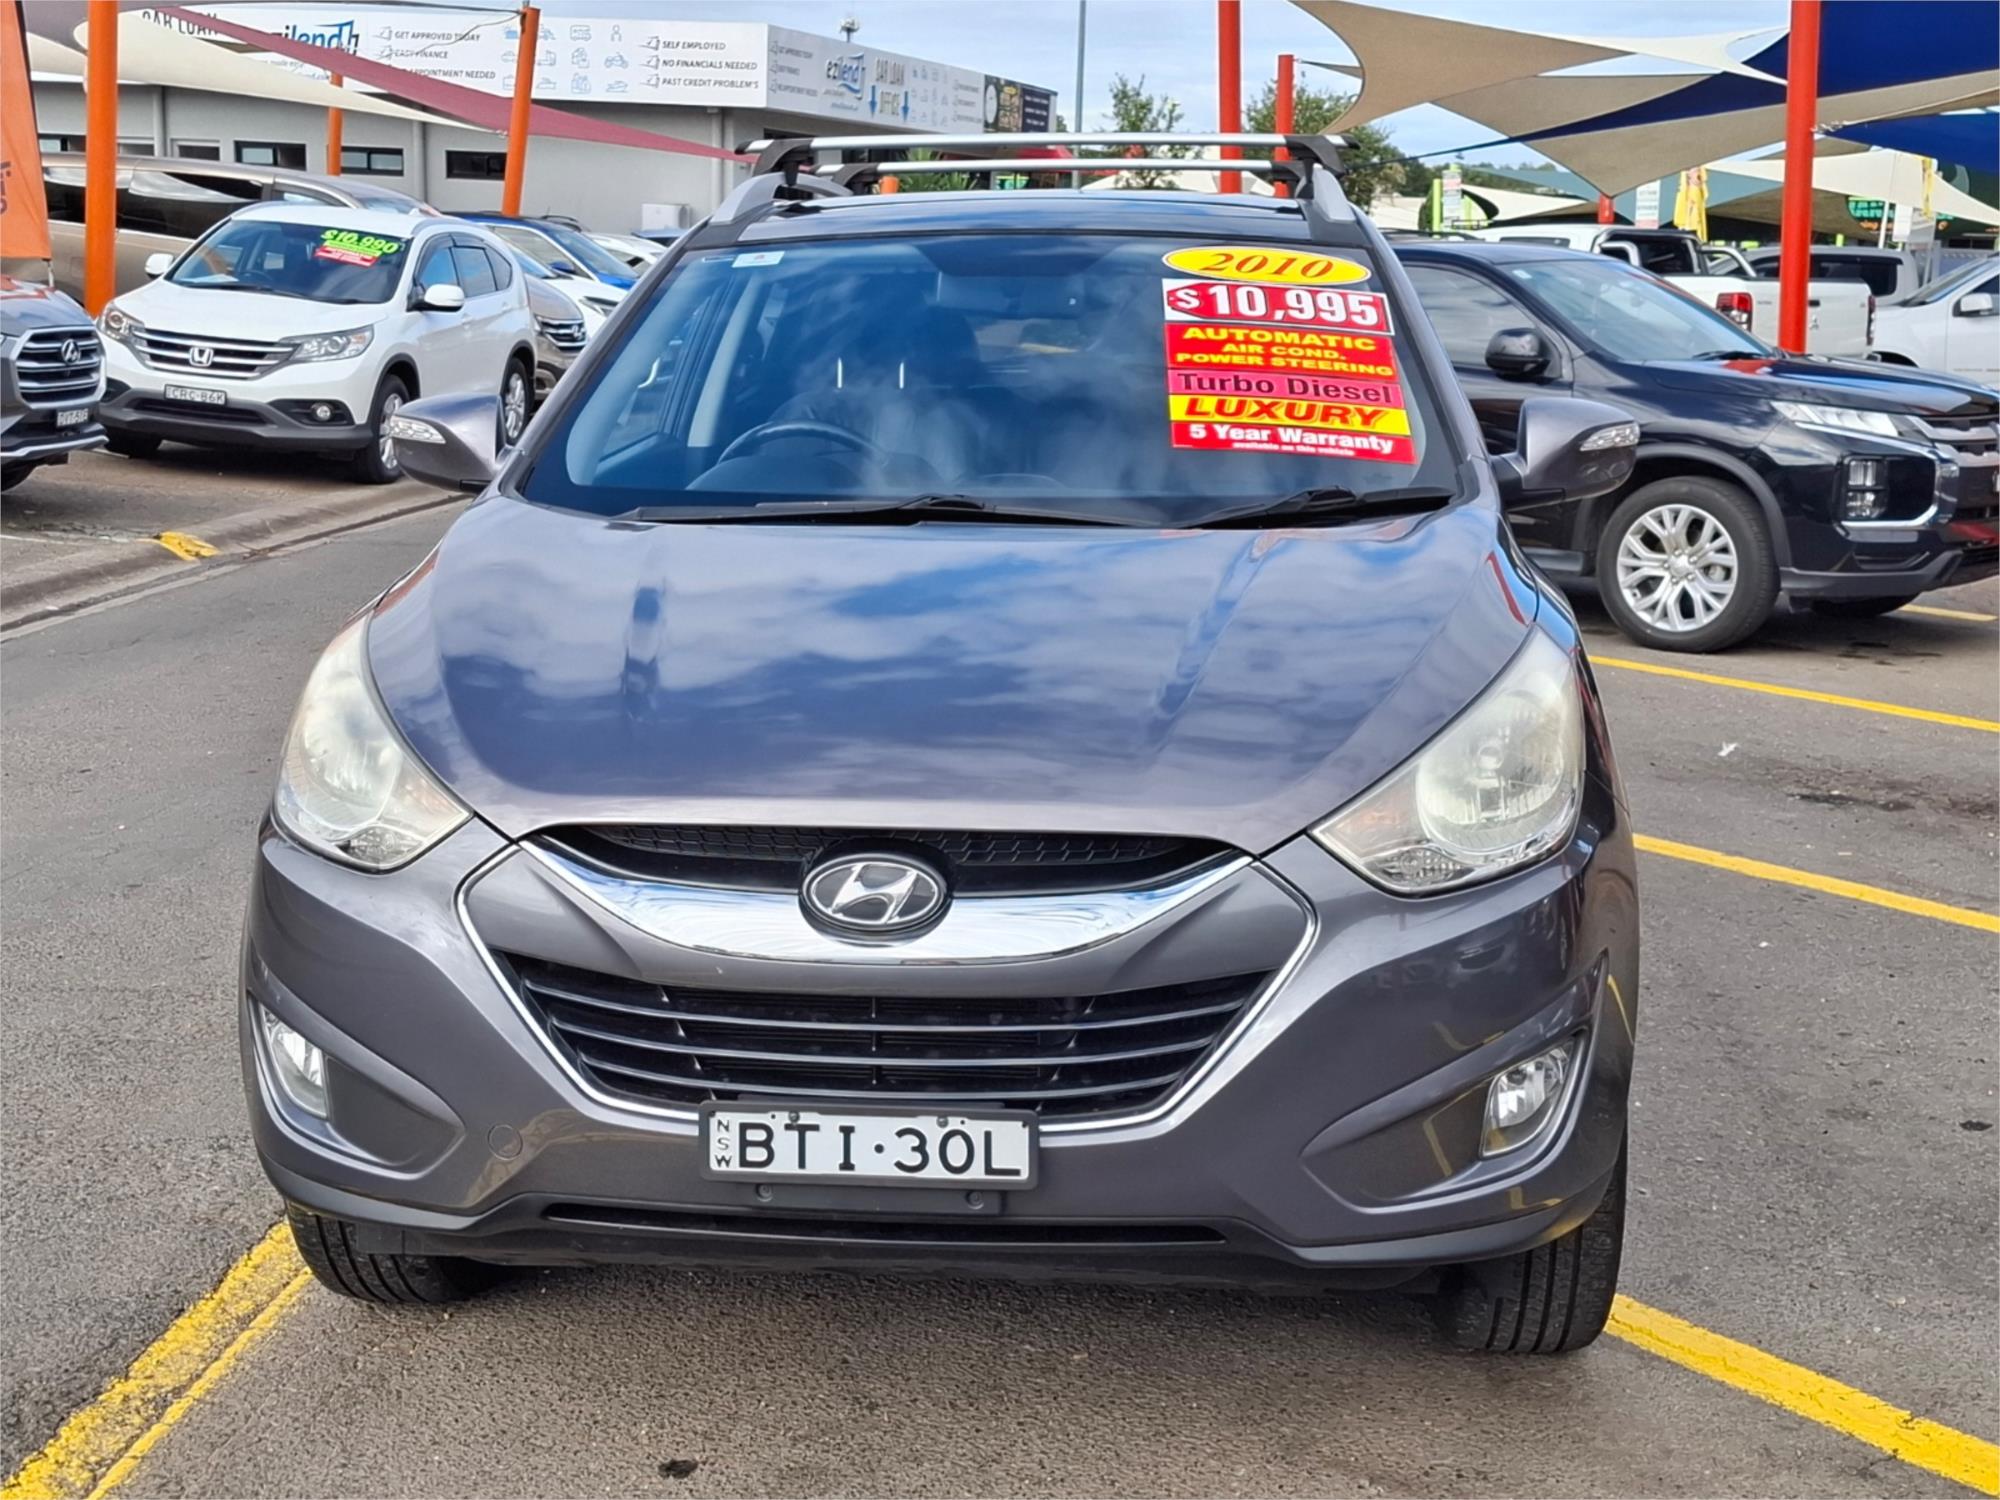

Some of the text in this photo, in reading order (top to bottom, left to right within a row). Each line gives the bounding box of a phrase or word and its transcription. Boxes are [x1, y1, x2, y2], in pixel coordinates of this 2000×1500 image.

[394, 31, 410, 40] GET
[411, 32, 453, 41] APPROVED
[662, 40, 726, 51] SELF EMPLOYED
[465, 70, 496, 80] NEEDED
[662, 59, 758, 71] NO FINANCIALS NEEDED
[661, 77, 759, 89] PAST CREDIT PROBLEM'S
[1201, 252, 1334, 279] 2010
[1175, 284, 1379, 327] $10,995
[1183, 327, 1377, 351] AUTOMATIC
[1222, 343, 1347, 360] AIR COND.
[1176, 352, 1394, 376] POWER STEERING
[1177, 372, 1392, 404] Turbo Diesel
[1185, 398, 1388, 427] LUXURY
[1189, 424, 1394, 455] 5 Year Warranty
